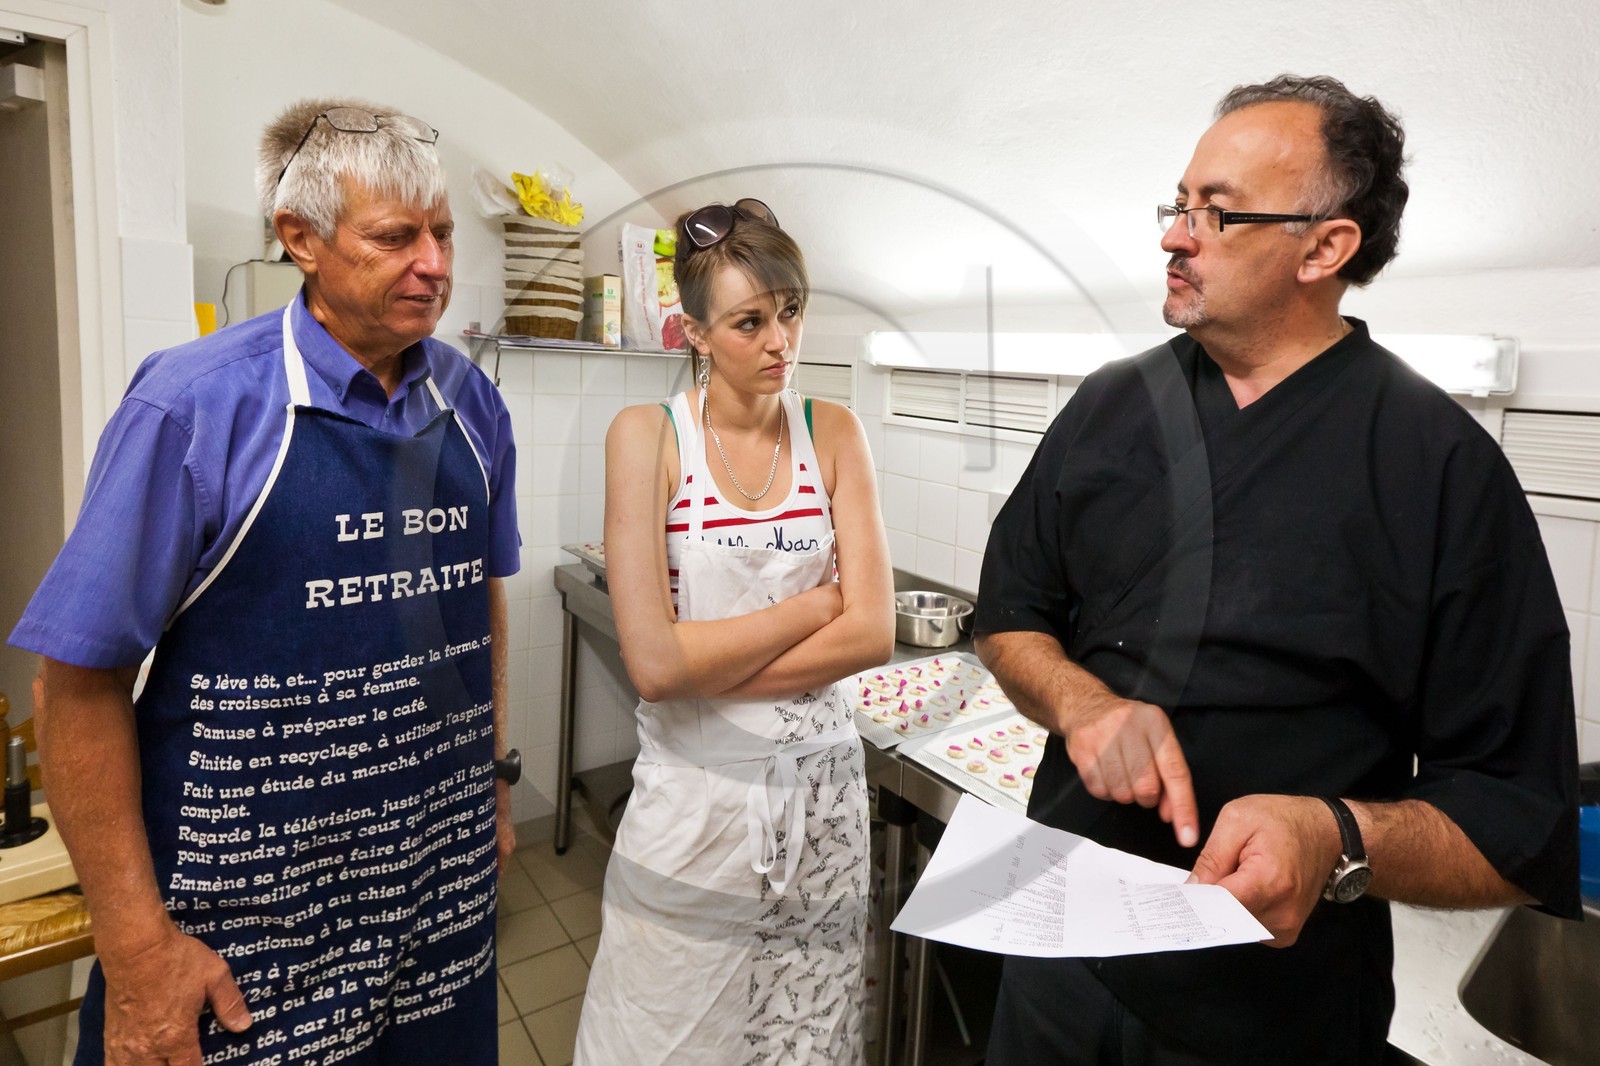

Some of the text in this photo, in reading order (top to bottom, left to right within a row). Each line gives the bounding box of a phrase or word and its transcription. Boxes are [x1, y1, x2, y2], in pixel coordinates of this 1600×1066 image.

[335, 506, 469, 542] LE BON
[305, 557, 484, 609] RETRAITE
[190, 674, 210, 690] Se
[214, 673, 248, 690] lève
[254, 674, 281, 690] tôt,
[286, 673, 317, 687] et...
[323, 667, 366, 687] pour
[372, 655, 425, 679] garder
[428, 649, 441, 662] la
[445, 639, 480, 658] forme,
[190, 676, 421, 711] des croissants à sa femme.
[188, 750, 243, 771] S'initie
[249, 755, 273, 769] en
[279, 742, 372, 766] recyclage,
[377, 733, 389, 749] à
[395, 720, 443, 745] utiliser
[192, 696, 428, 740] S'amuse à préparer le café.
[183, 724, 493, 799] Fait une étude du marché, et en fait un
[177, 777, 495, 866] pour rendre jaloux ceux qui travaillent
[178, 825, 252, 848] Regarde
[258, 823, 277, 838] la
[283, 807, 376, 835] télévision,
[381, 793, 421, 818] juste
[423, 785, 436, 799] ce
[438, 768, 466, 793] qu'il
[180, 804, 251, 824] complet.
[165, 897, 188, 911] de
[193, 898, 211, 911] la
[218, 881, 311, 905] conseiller
[316, 872, 333, 887] et
[338, 832, 452, 881] éventuellement
[457, 828, 471, 841] la
[169, 873, 247, 892] Emmène
[253, 872, 275, 886] sa
[282, 853, 344, 880] femme
[350, 844, 395, 862] faire
[399, 834, 423, 851] des
[425, 809, 474, 838] courses
[175, 920, 216, 935] ient
[222, 902, 323, 931] compagnie
[328, 893, 352, 908] au
[357, 884, 407, 901] chien
[411, 864, 436, 890] sans
[214, 934, 315, 959] rfectionne
[319, 923, 331, 939] à
[336, 917, 353, 931] la
[359, 902, 418, 925] cuisine
[418, 890, 434, 906] en
[267, 963, 280, 980] à
[287, 946, 345, 980] portée
[349, 938, 371, 953] de
[377, 935, 393, 949] la
[436, 907, 454, 923] sa
[283, 980, 296, 993] à
[302, 952, 393, 988] intervenir
[427, 911, 485, 944] moindre
[202, 1043, 251, 1066] uche
[257, 1029, 288, 1049] tôt,
[293, 1017, 327, 1037] car
[332, 1008, 346, 1025] il
[351, 1006, 363, 1019] a
[415, 972, 436, 986] de
[282, 996, 306, 1012] ou
[311, 984, 335, 1002] de
[341, 979, 358, 995] la
[288, 1021, 371, 1060] nostalgie
[393, 994, 423, 1008] bon
[428, 974, 472, 999] vieux
[396, 996, 456, 1024] travail.
